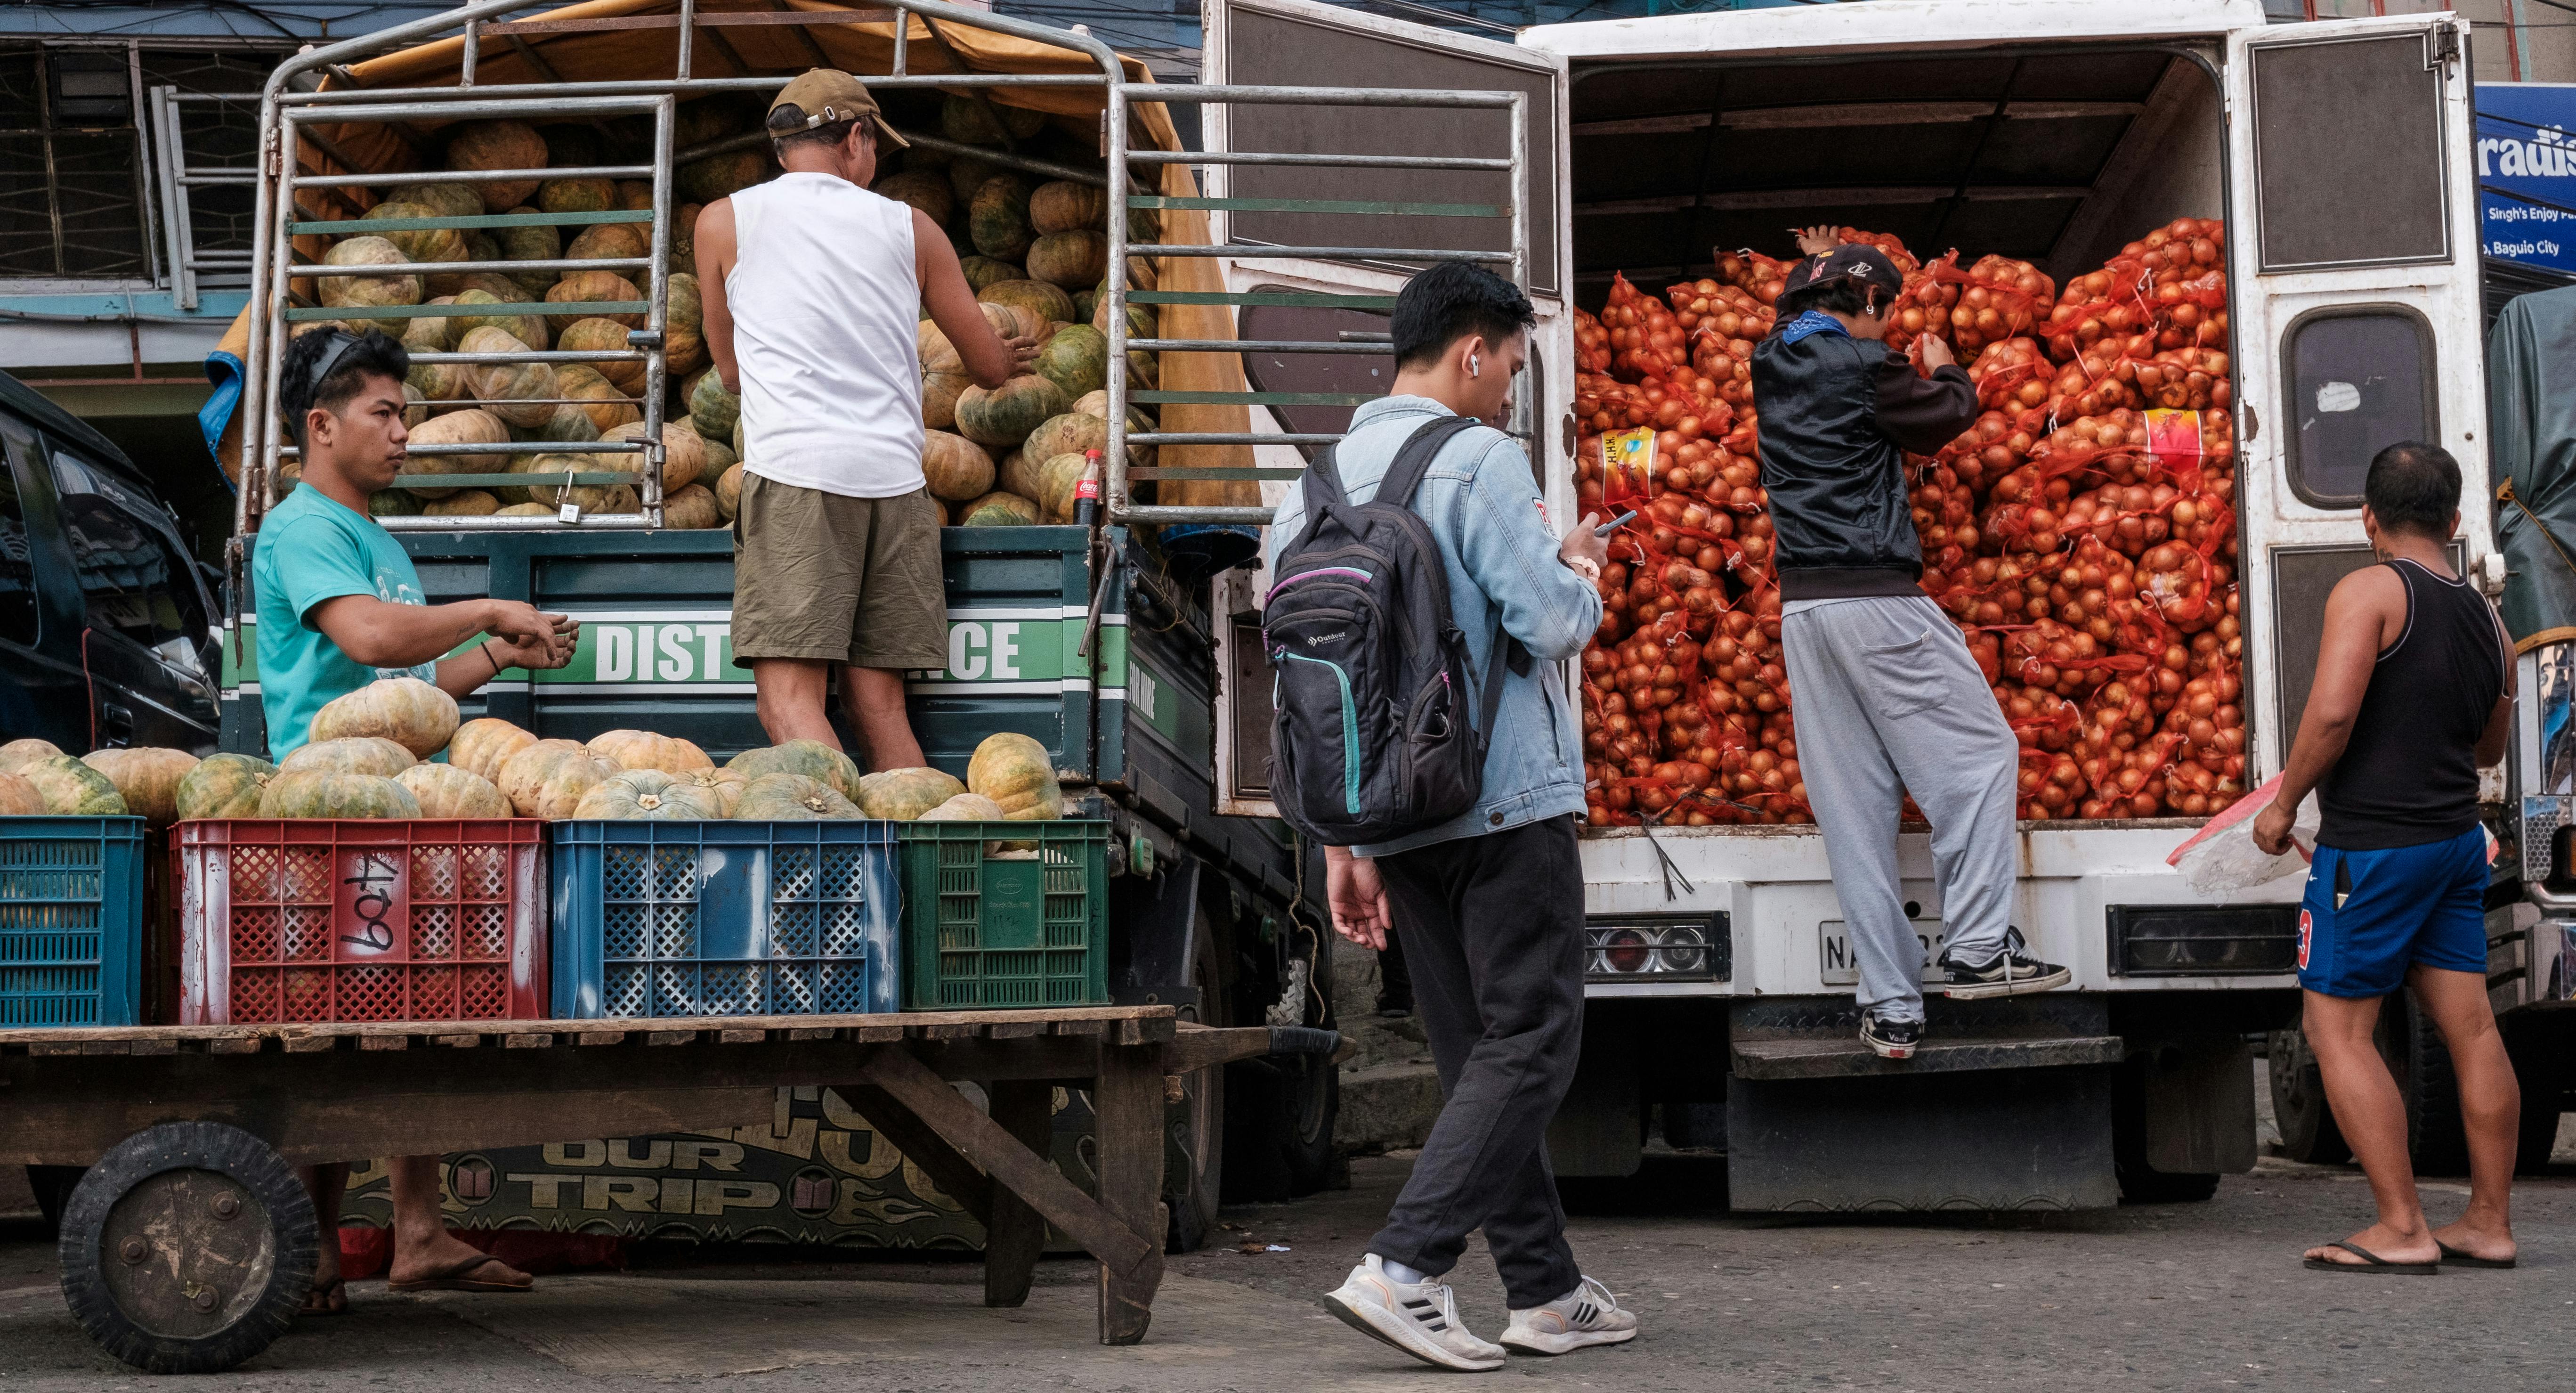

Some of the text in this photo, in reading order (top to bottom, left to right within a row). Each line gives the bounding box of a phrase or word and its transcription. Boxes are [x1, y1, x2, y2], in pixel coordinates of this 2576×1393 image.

[2489, 207, 2527, 222] Singh's
[2530, 207, 2558, 222] Enjoy
[2493, 240, 2535, 257] Baguio
[2536, 239, 2559, 257] City
[1317, 632, 1345, 642] Outdoor
[1140, 670, 1156, 720] HIRE
[1887, 1032, 1910, 1043] Vans
[542, 1139, 746, 1173] OUR
[506, 1173, 781, 1216] TRIP
